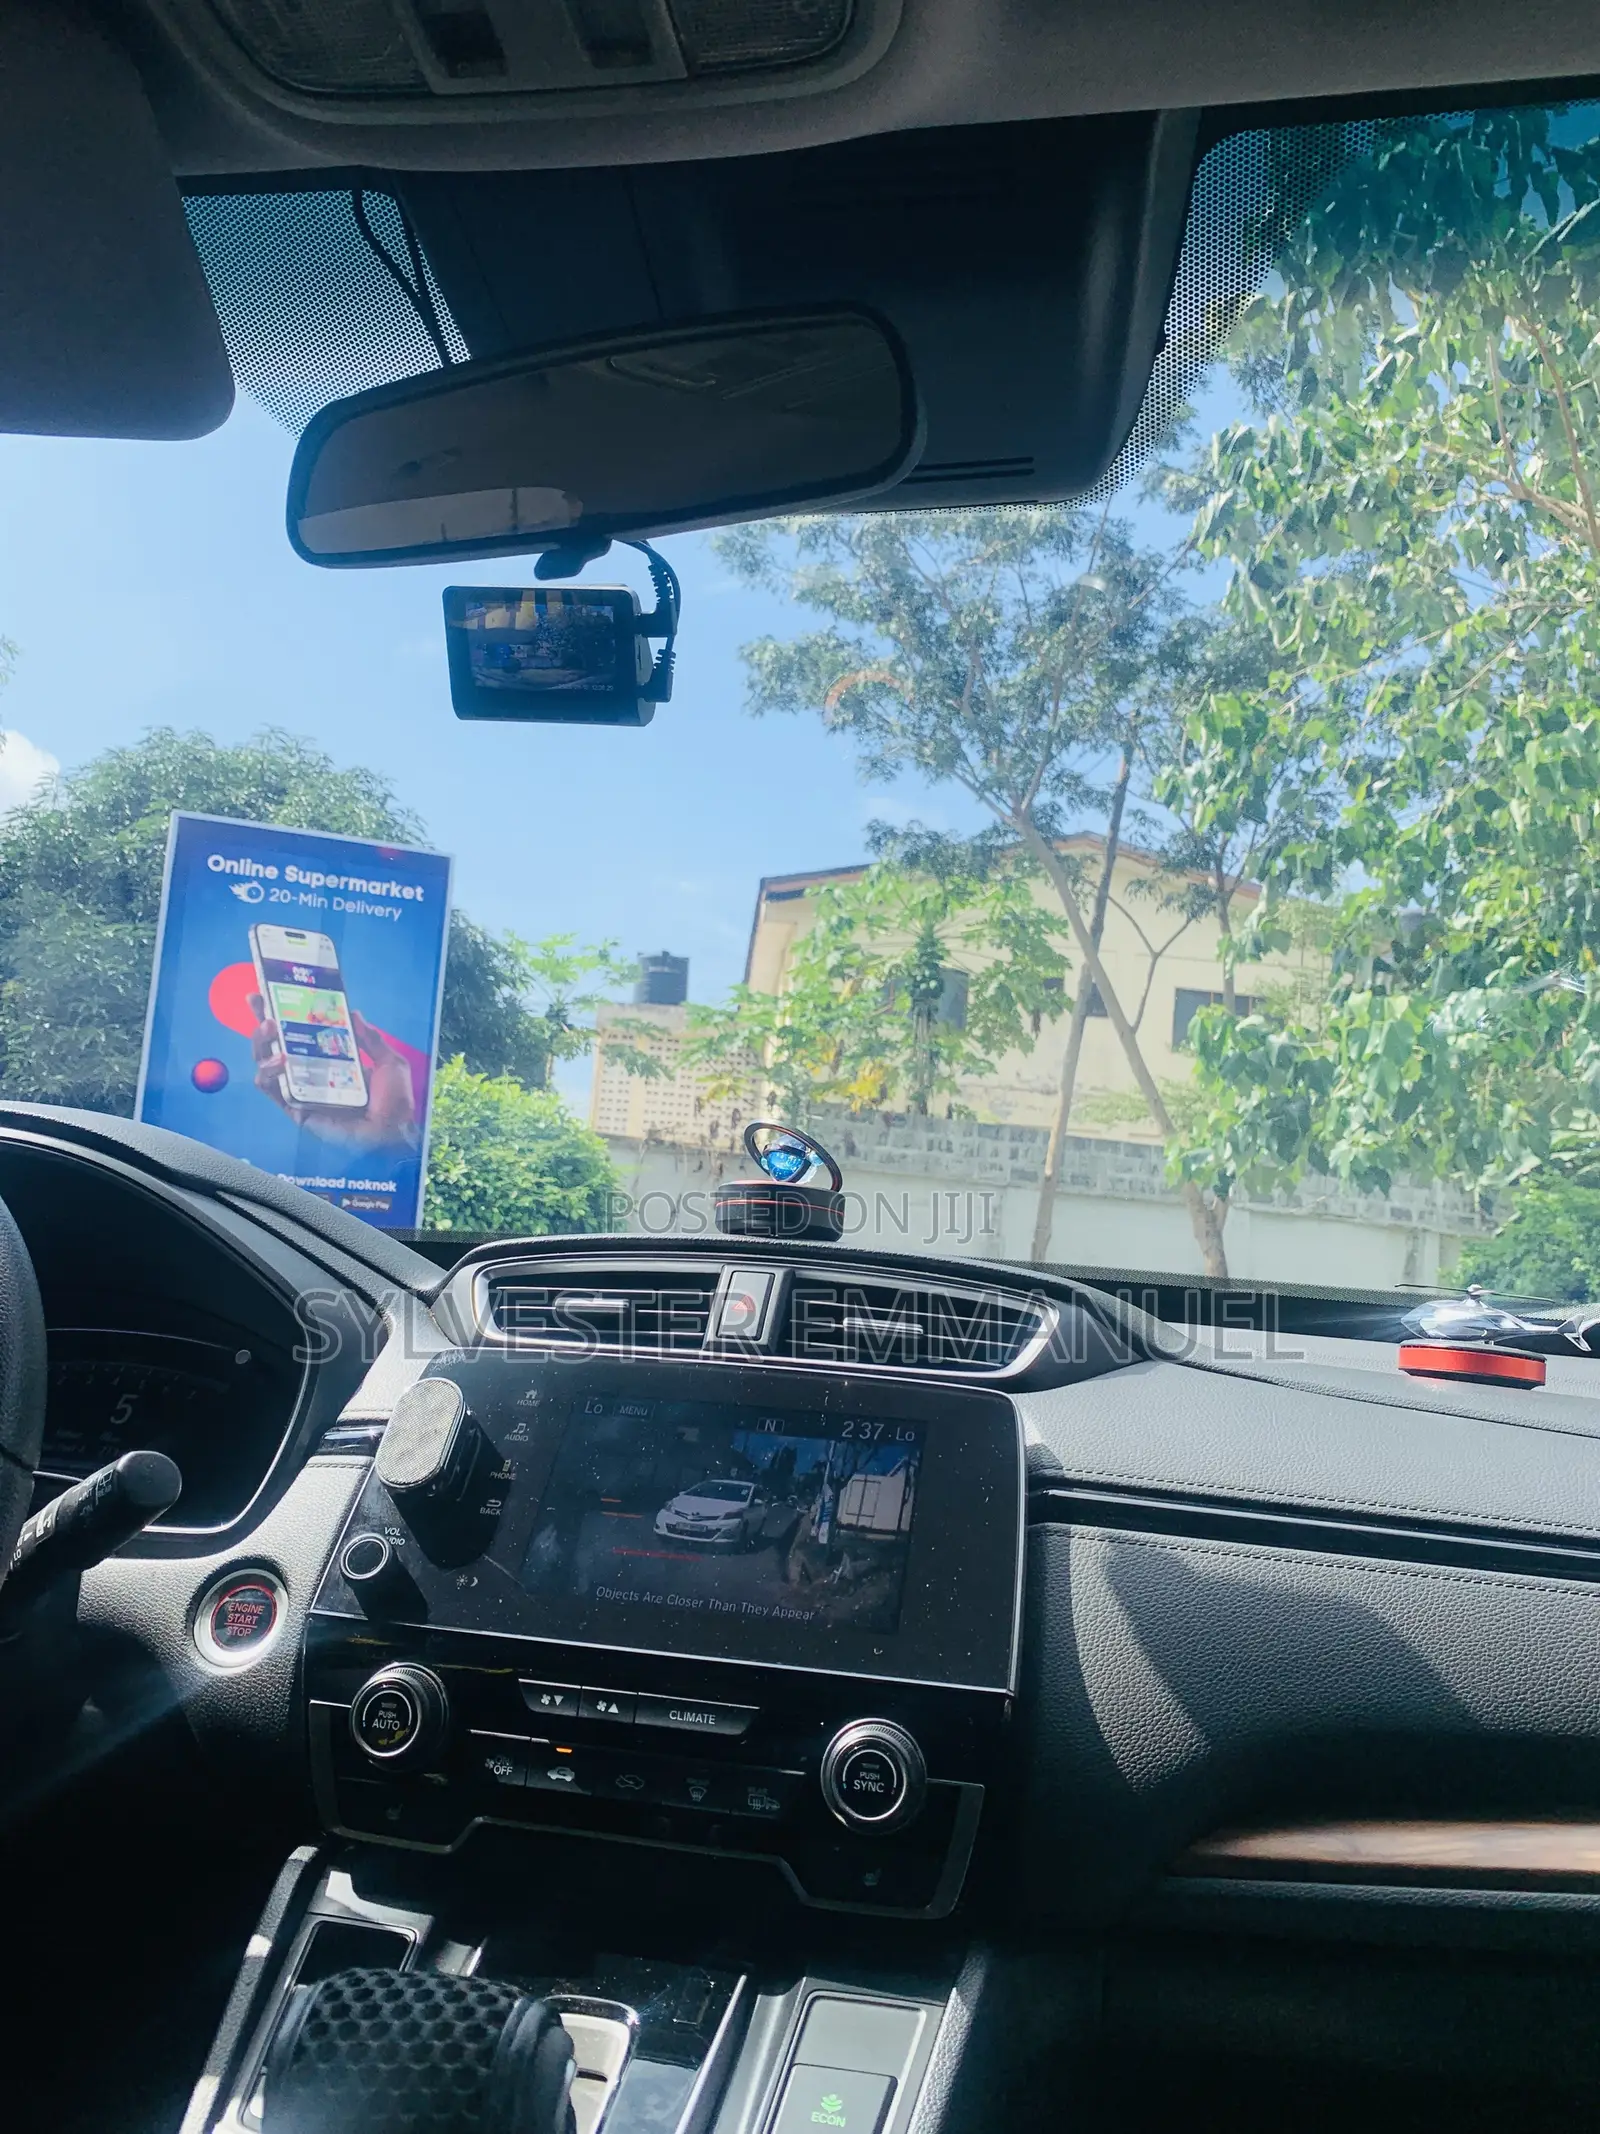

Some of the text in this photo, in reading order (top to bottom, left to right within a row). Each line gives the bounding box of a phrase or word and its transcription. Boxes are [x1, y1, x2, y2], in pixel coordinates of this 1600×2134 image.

[207, 854, 425, 901] Online Supermarket
[269, 888, 402, 921] 20-Min Delivery
[348, 1179, 397, 1192] noknok
[110, 1393, 140, 1425] 5
[516, 1399, 541, 1408] HOME
[584, 1400, 604, 1414] Lo
[619, 1404, 648, 1416] MENU
[764, 1419, 777, 1433] N
[504, 1433, 529, 1442] AUDIO
[490, 1471, 517, 1481] PHONE
[479, 1507, 502, 1516] BACK
[384, 1526, 401, 1536] VOL
[228, 1602, 266, 1615] ENGINE
[596, 1586, 815, 1621] Objects Are Closer Than They Appear
[227, 1613, 259, 1625] START
[226, 1626, 251, 1637] STOP
[378, 1710, 397, 1719] PUSH
[669, 1710, 716, 1726] CLIMATE
[372, 1718, 400, 1731] AUTO
[493, 1765, 514, 1776] OFF
[859, 1771, 880, 1780] PUSH
[853, 1779, 885, 1793] SYNC
[811, 2111, 846, 2128] ECON
